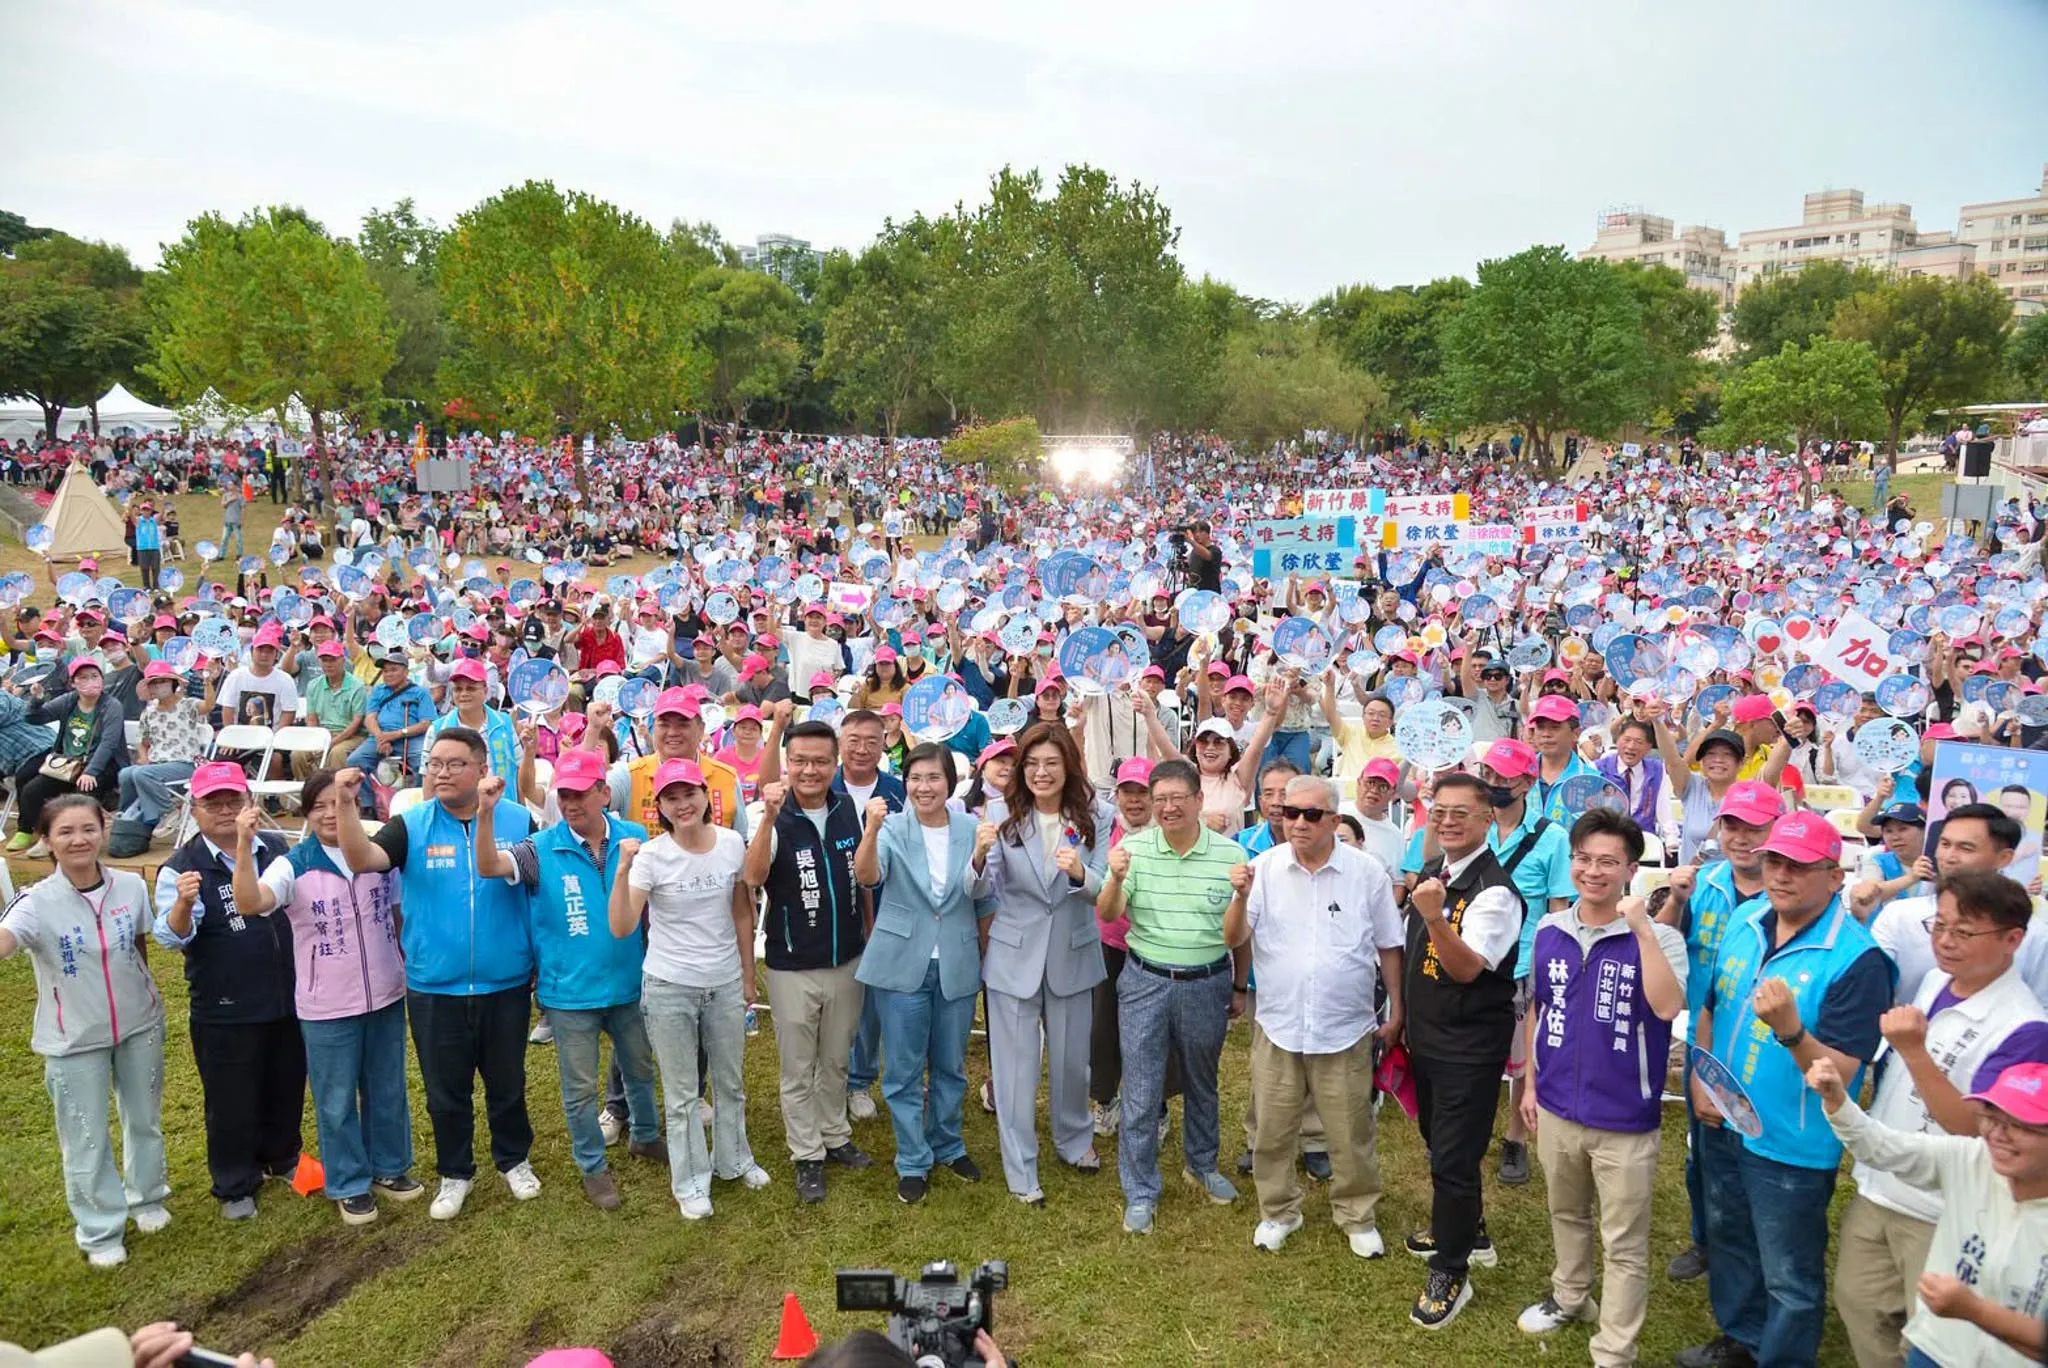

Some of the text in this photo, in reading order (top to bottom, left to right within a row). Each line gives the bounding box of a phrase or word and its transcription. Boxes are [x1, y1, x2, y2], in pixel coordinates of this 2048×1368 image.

[1306, 491, 1368, 511] 新竹縣
[1384, 500, 1452, 517] 唯一支持
[1525, 508, 1575, 522] 唯一支持
[1256, 525, 1336, 545] 唯一支持
[1406, 523, 1460, 541] 徐欣瑩
[1542, 525, 1581, 539] 徐欣瑩
[1281, 550, 1343, 573] 徐欣瑩
[1333, 583, 1358, 601] 徐欣
[1837, 637, 1888, 678] 加
[835, 837, 856, 851] KMT
[796, 848, 821, 910] 吳旭智
[1598, 962, 1617, 1019] 竹北東區
[1613, 964, 1637, 1052] 新竹縣議員
